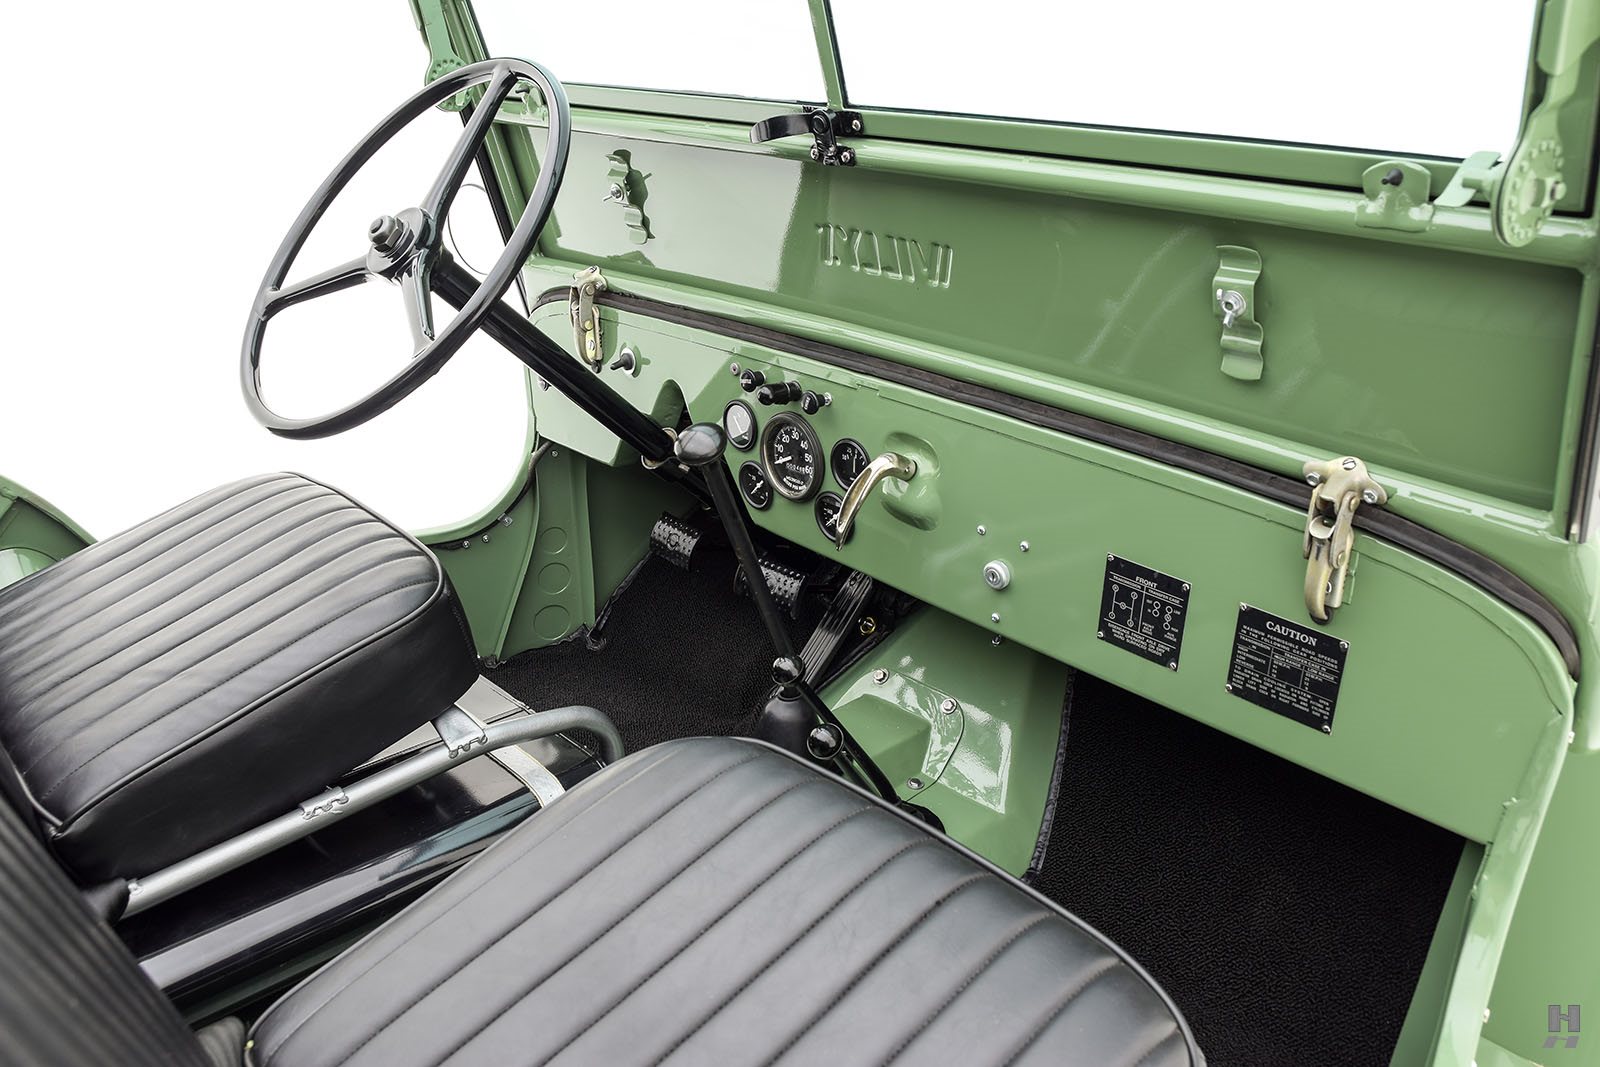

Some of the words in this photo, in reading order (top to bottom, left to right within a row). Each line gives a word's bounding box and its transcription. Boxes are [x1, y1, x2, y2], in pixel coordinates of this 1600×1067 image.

[782, 433, 790, 444] 20
[791, 430, 800, 440] 30
[778, 443, 784, 453] 10
[800, 440, 808, 450] 40
[804, 453, 813, 463] 50
[805, 465, 813, 475] 60
[1136, 576, 1158, 588] FRONT
[1266, 621, 1317, 646] CAUTION
[1242, 625, 1264, 636] MAXIMUM
[1267, 634, 1298, 648] PERMISSIBLE
[1318, 654, 1337, 663] SPEEDS
[1261, 637, 1289, 650] FOLLOWING
[1310, 655, 1337, 668] POSITIONS
[1284, 653, 1307, 664] TRANSFER
[1244, 669, 1258, 677] DRAIN
[1264, 677, 1285, 688] COOLING
